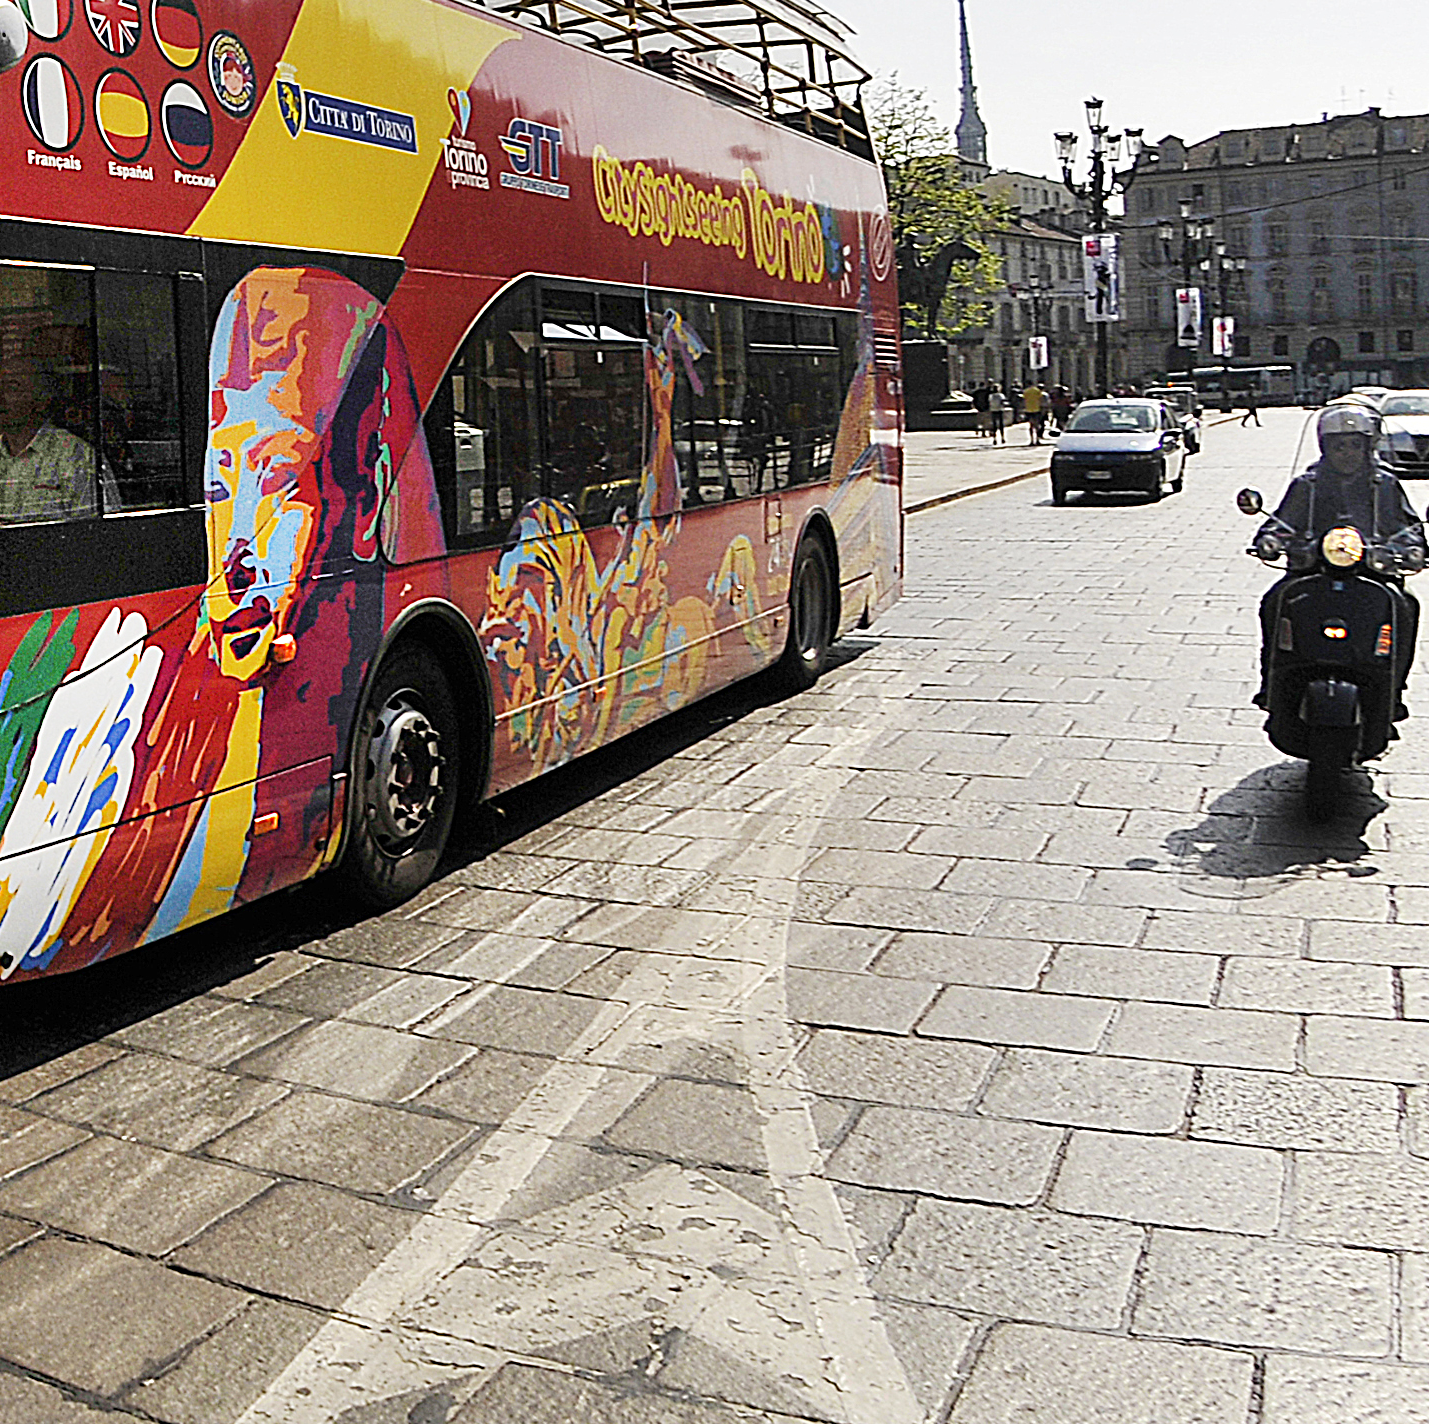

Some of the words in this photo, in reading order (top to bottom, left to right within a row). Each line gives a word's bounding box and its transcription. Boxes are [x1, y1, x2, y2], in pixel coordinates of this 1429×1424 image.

[351, 112, 366, 134] DI
[366, 110, 413, 144] TORINO
[26, 149, 83, 172] Français
[439, 137, 488, 176] Torino
[498, 117, 564, 181] GTT
[107, 160, 154, 181] Español
[741, 166, 826, 284] Torino
